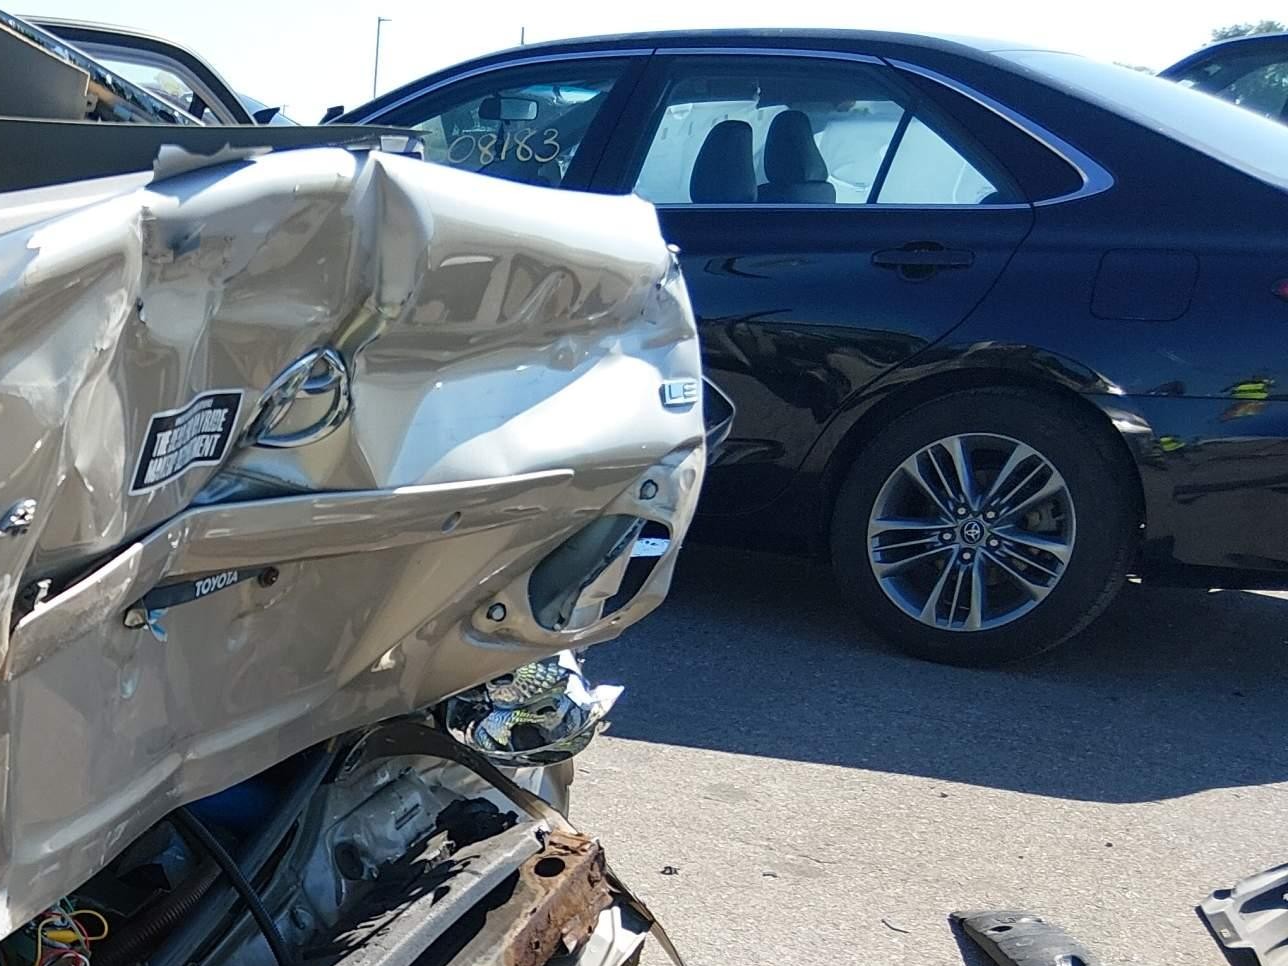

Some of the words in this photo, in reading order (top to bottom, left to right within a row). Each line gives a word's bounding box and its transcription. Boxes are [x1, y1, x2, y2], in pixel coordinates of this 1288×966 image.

[447, 127, 561, 166] 08183
[666, 382, 697, 403] LE
[194, 570, 240, 598] TOYOTA
